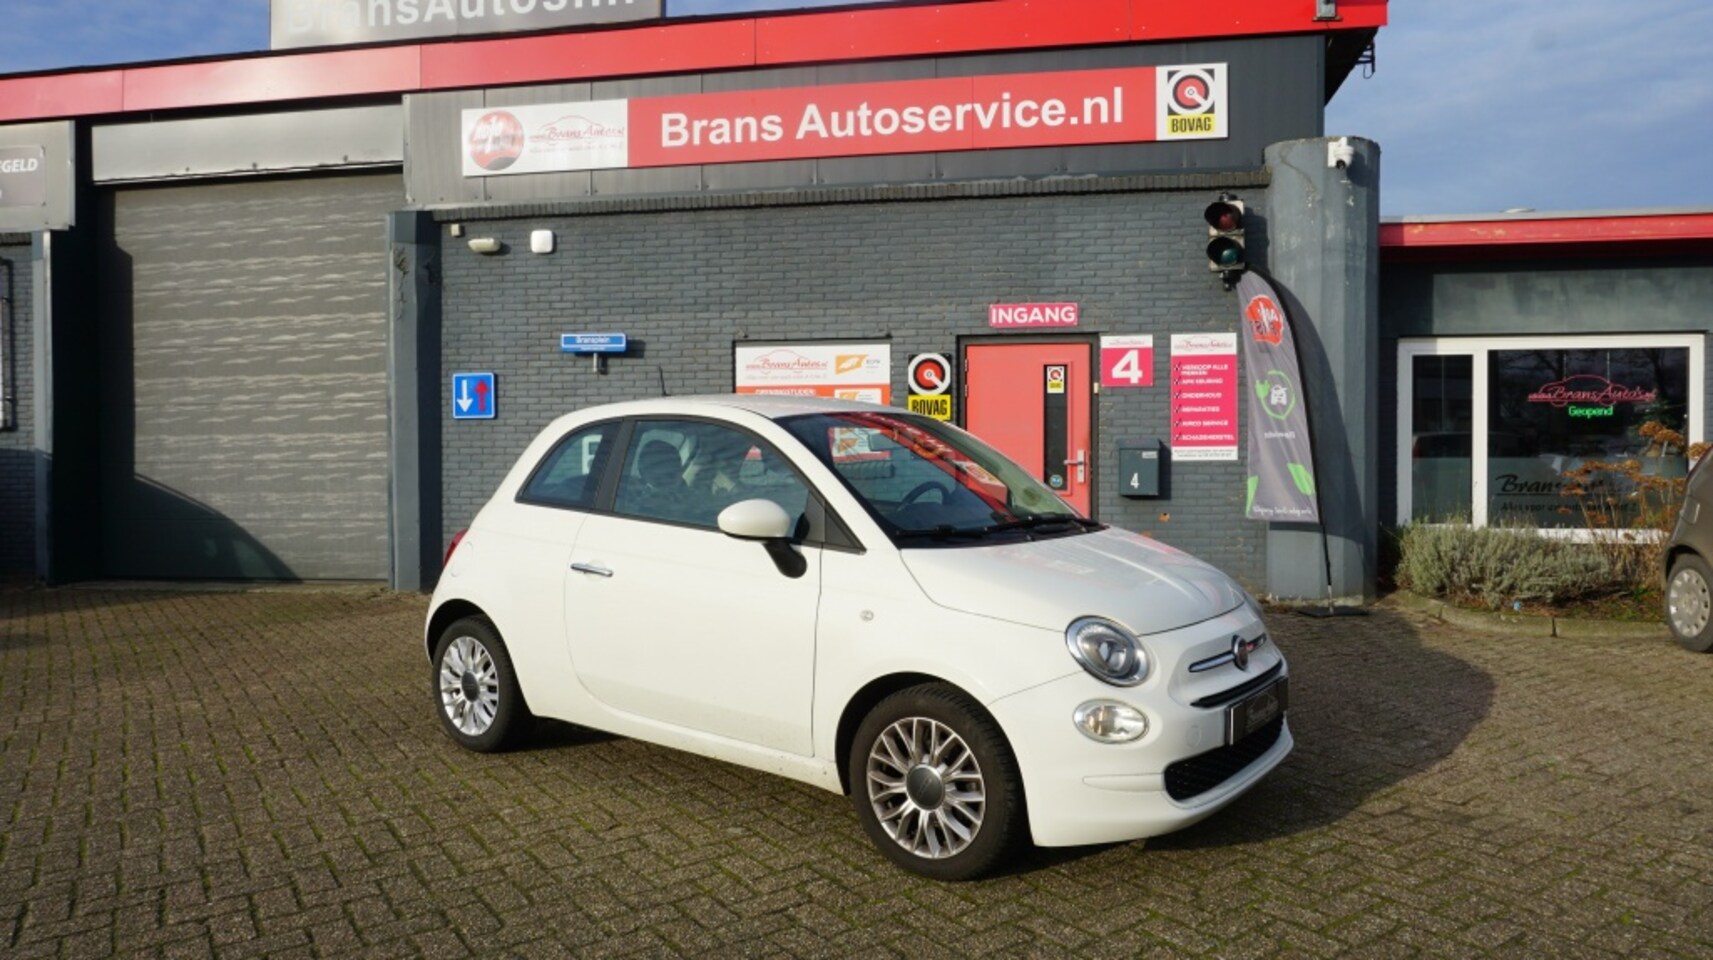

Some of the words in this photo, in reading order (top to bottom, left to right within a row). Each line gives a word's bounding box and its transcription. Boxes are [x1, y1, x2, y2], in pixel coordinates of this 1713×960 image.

[661, 112, 784, 147] Brans
[795, 86, 1122, 140] Autoservice.nl
[1171, 116, 1212, 132] BOVAG
[0, 159, 38, 173] GELD
[991, 306, 1076, 324] INGANG
[1111, 350, 1143, 384] 4
[912, 399, 948, 416] BOVAG
[1568, 405, 1614, 419] Geopend
[1130, 472, 1140, 489] 4
